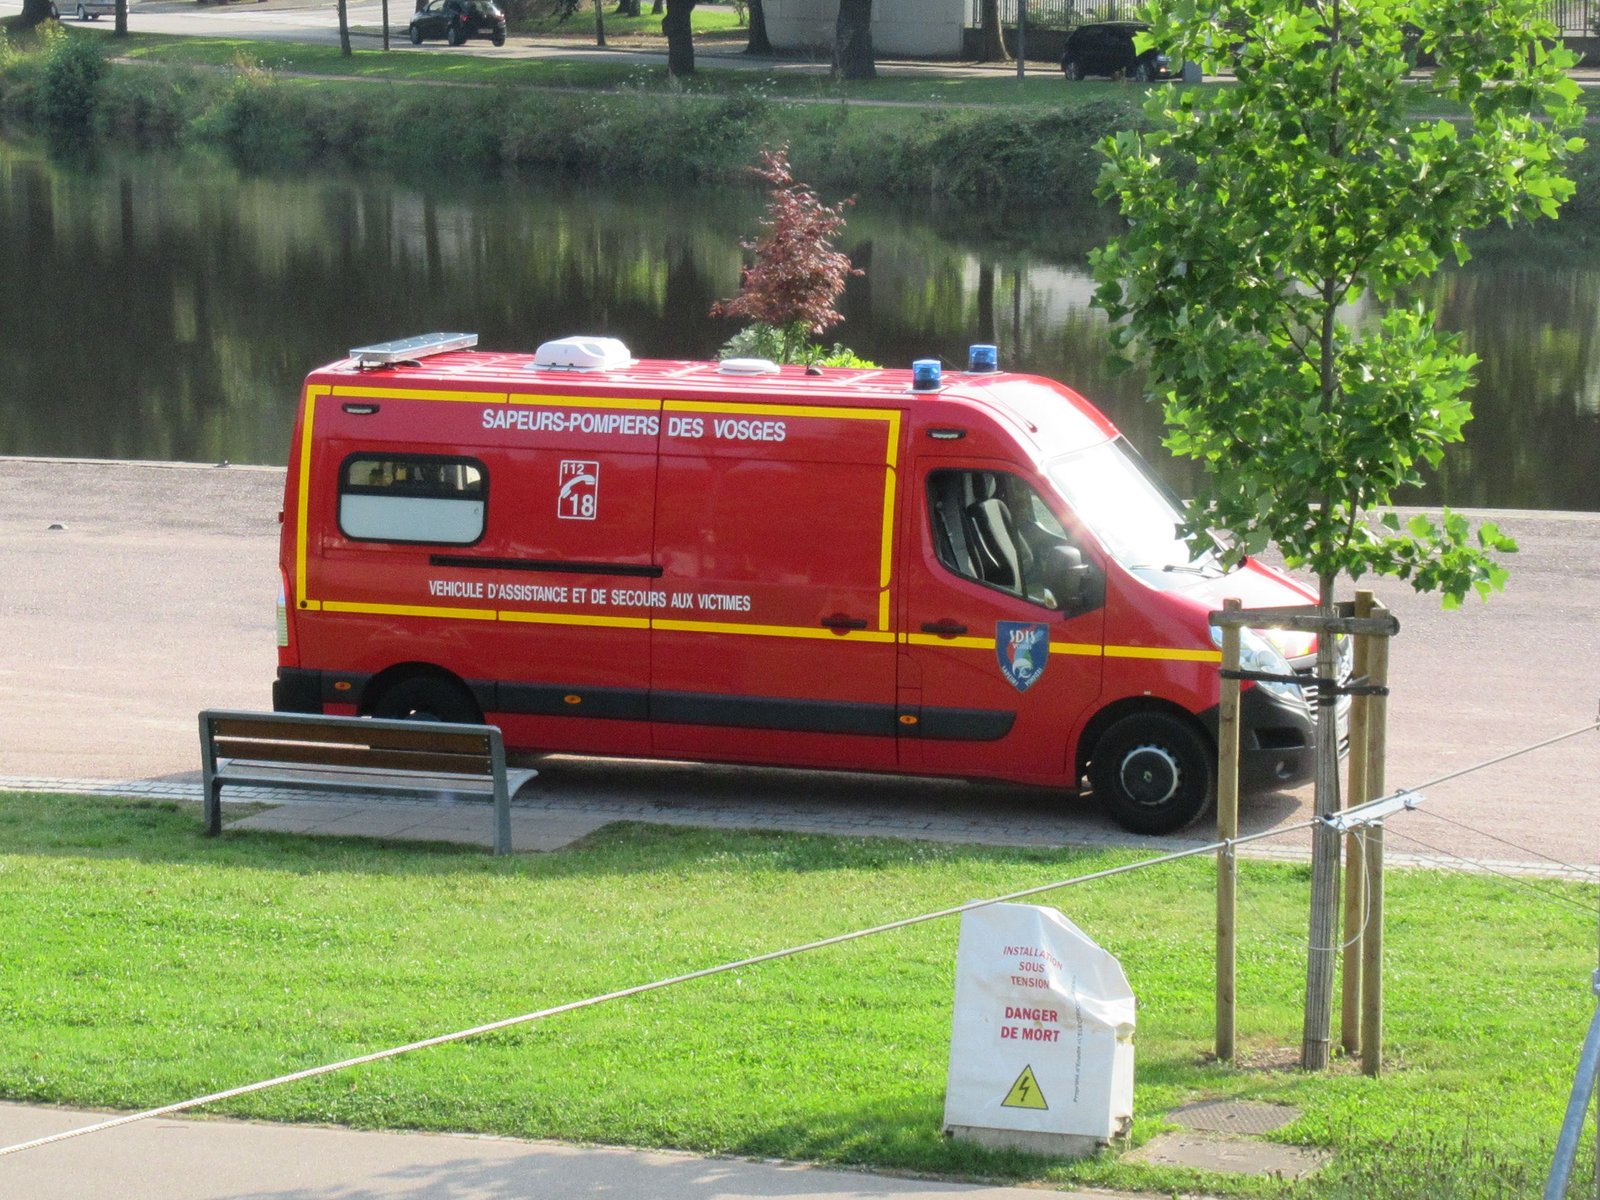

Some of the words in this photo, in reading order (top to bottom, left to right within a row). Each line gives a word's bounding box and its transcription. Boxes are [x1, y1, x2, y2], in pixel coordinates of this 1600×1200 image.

[482, 408, 660, 436] SAPEURS-POMPIERS
[668, 417, 704, 438] DES
[713, 419, 786, 442] VOSGES
[563, 463, 585, 475] 112
[570, 494, 594, 516] 18
[429, 580, 483, 599] VEHICULE
[487, 584, 568, 603] D'ASSISTANCE
[572, 588, 587, 603] ET
[591, 588, 607, 605] DE
[610, 590, 667, 608] SECOURS
[670, 592, 694, 609] AUX
[697, 593, 751, 612] VICTIMES
[1009, 629, 1036, 644] SDIS
[1003, 945, 1063, 971] INSTALLATION
[1018, 961, 1045, 973] SOUS
[1010, 976, 1050, 989] TENSION
[1004, 1006, 1058, 1022] DANGER
[1000, 1026, 1018, 1039] DE
[1021, 1028, 1061, 1043] MORT
